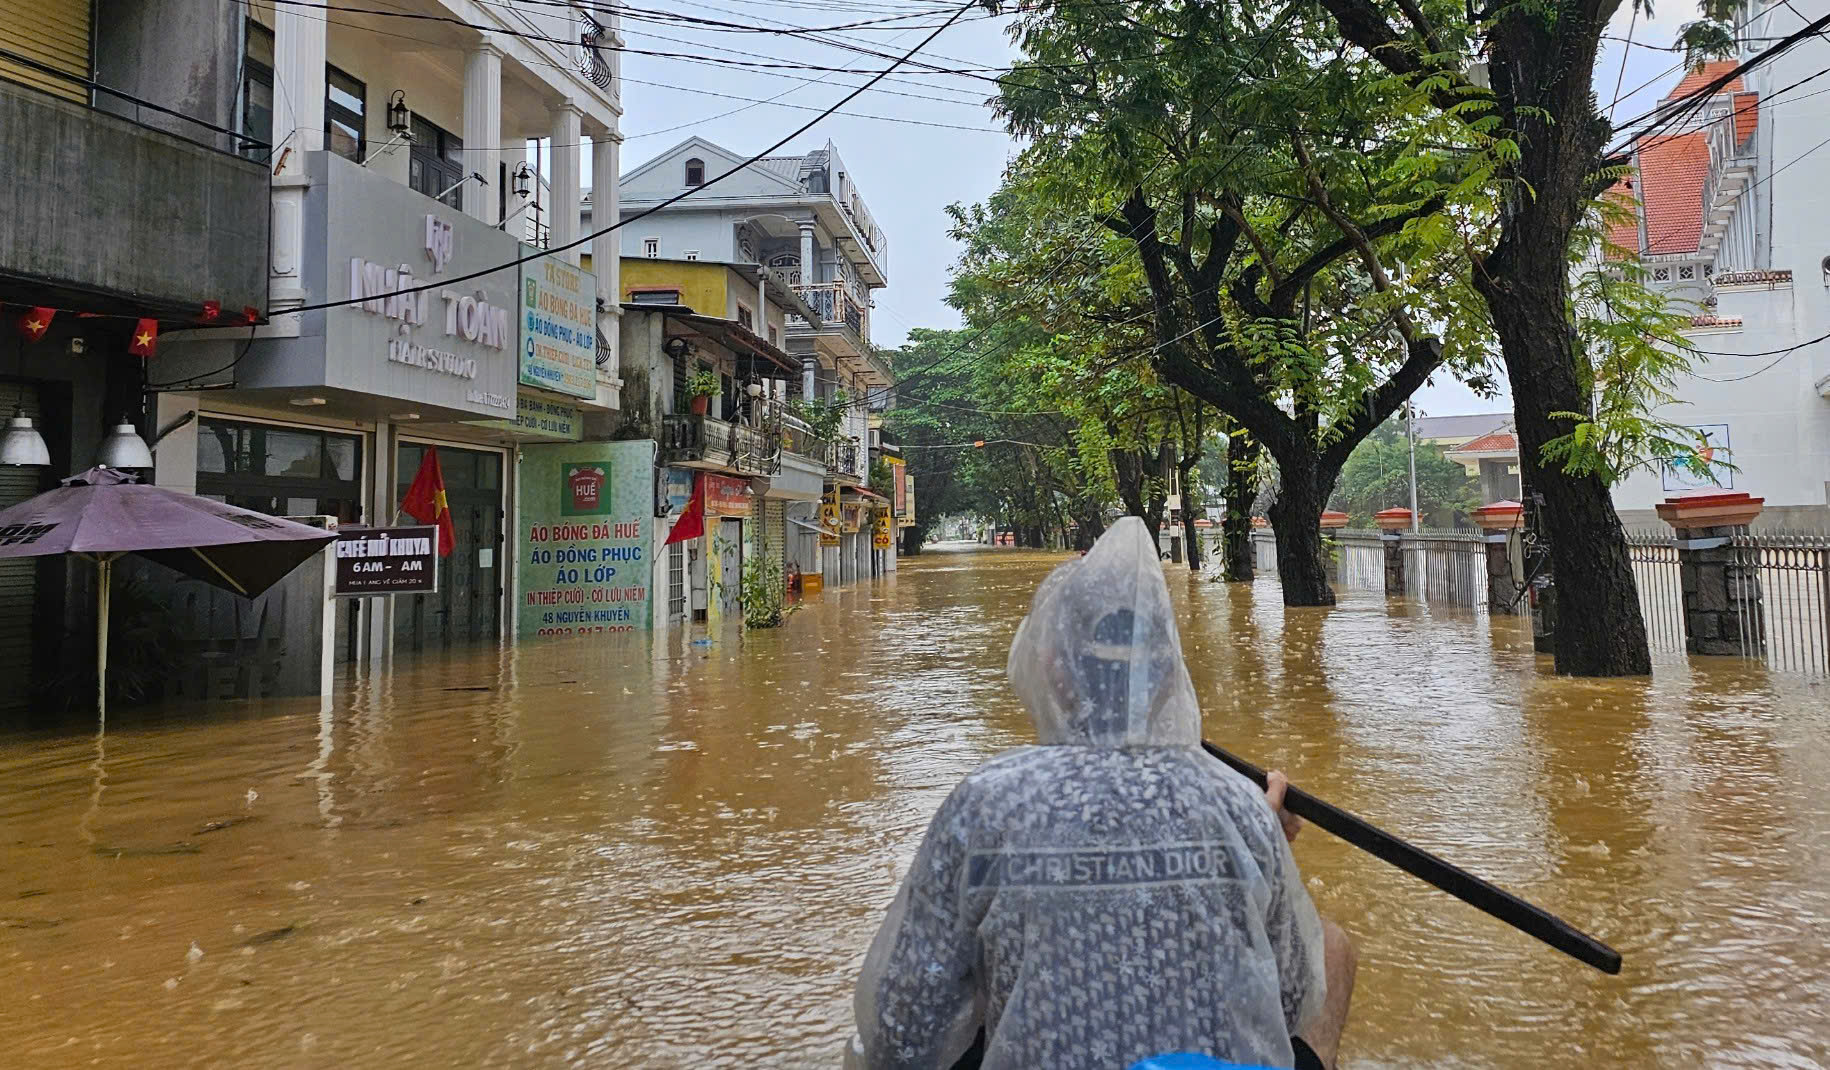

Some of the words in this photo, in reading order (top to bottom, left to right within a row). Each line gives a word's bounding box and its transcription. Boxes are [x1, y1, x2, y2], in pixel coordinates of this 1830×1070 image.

[441, 289, 508, 352] TOÀN
[576, 481, 597, 496] HUẾ
[530, 523, 548, 542] ÁO
[552, 521, 588, 541] BÓNG
[592, 520, 610, 539] ĐÁ
[614, 516, 642, 538] HUẾ
[337, 535, 367, 558] CAFÉ
[390, 537, 430, 556] KHUYA
[531, 547, 551, 564] ÁO
[556, 543, 597, 563] ĐỒNG
[602, 546, 642, 564] PHỤC
[556, 565, 578, 584] ÁO
[584, 564, 616, 583] LỚP
[527, 591, 536, 605] IN
[564, 585, 584, 604] CƯỚI
[542, 612, 553, 624] 48
[556, 606, 592, 623] NGUYỄN
[594, 605, 630, 621] KHUYẾN
[1006, 854, 1154, 881] CHRISTIAN
[1165, 850, 1229, 876] DIOR
